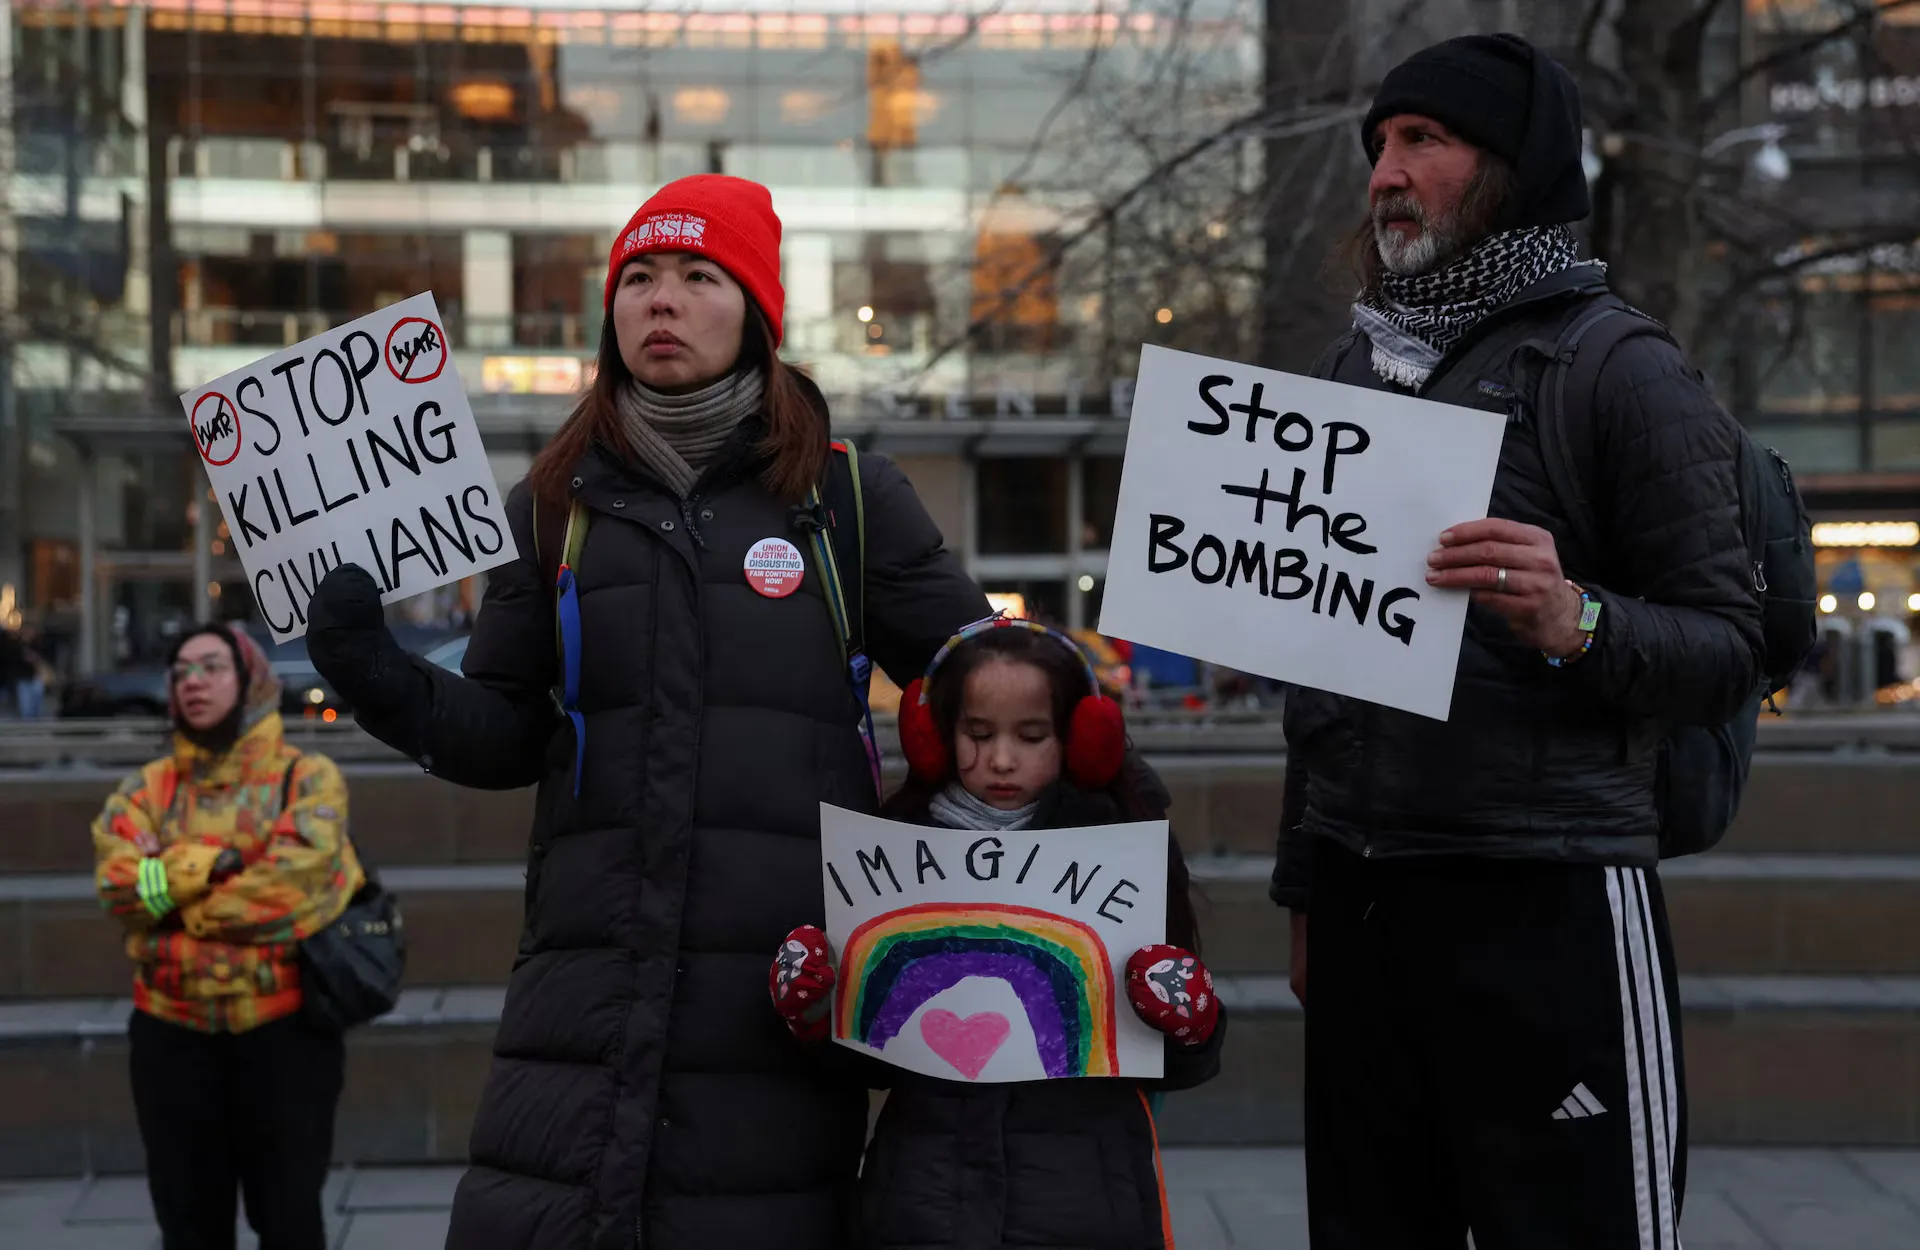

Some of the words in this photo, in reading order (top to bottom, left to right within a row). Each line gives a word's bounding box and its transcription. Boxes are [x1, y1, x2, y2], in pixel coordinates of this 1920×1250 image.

[623, 220, 706, 250] NURSES
[647, 214, 664, 222] New
[665, 212, 683, 221] York
[685, 213, 706, 224] State
[195, 412, 235, 446] WAR
[236, 330, 380, 456] STOP
[392, 331, 440, 364] WAR
[228, 400, 458, 548] KILLING
[1220, 467, 1378, 554] the
[255, 485, 504, 634] CIVIANS
[749, 559, 800, 568] DISGUSTING
[753, 551, 788, 559] BUSTING
[789, 552, 798, 560] IS
[764, 577, 783, 585] NOW!
[765, 570, 800, 578] CONTRACT
[1148, 513, 1420, 646] BOMBING
[826, 836, 1140, 923] IMAGINE
